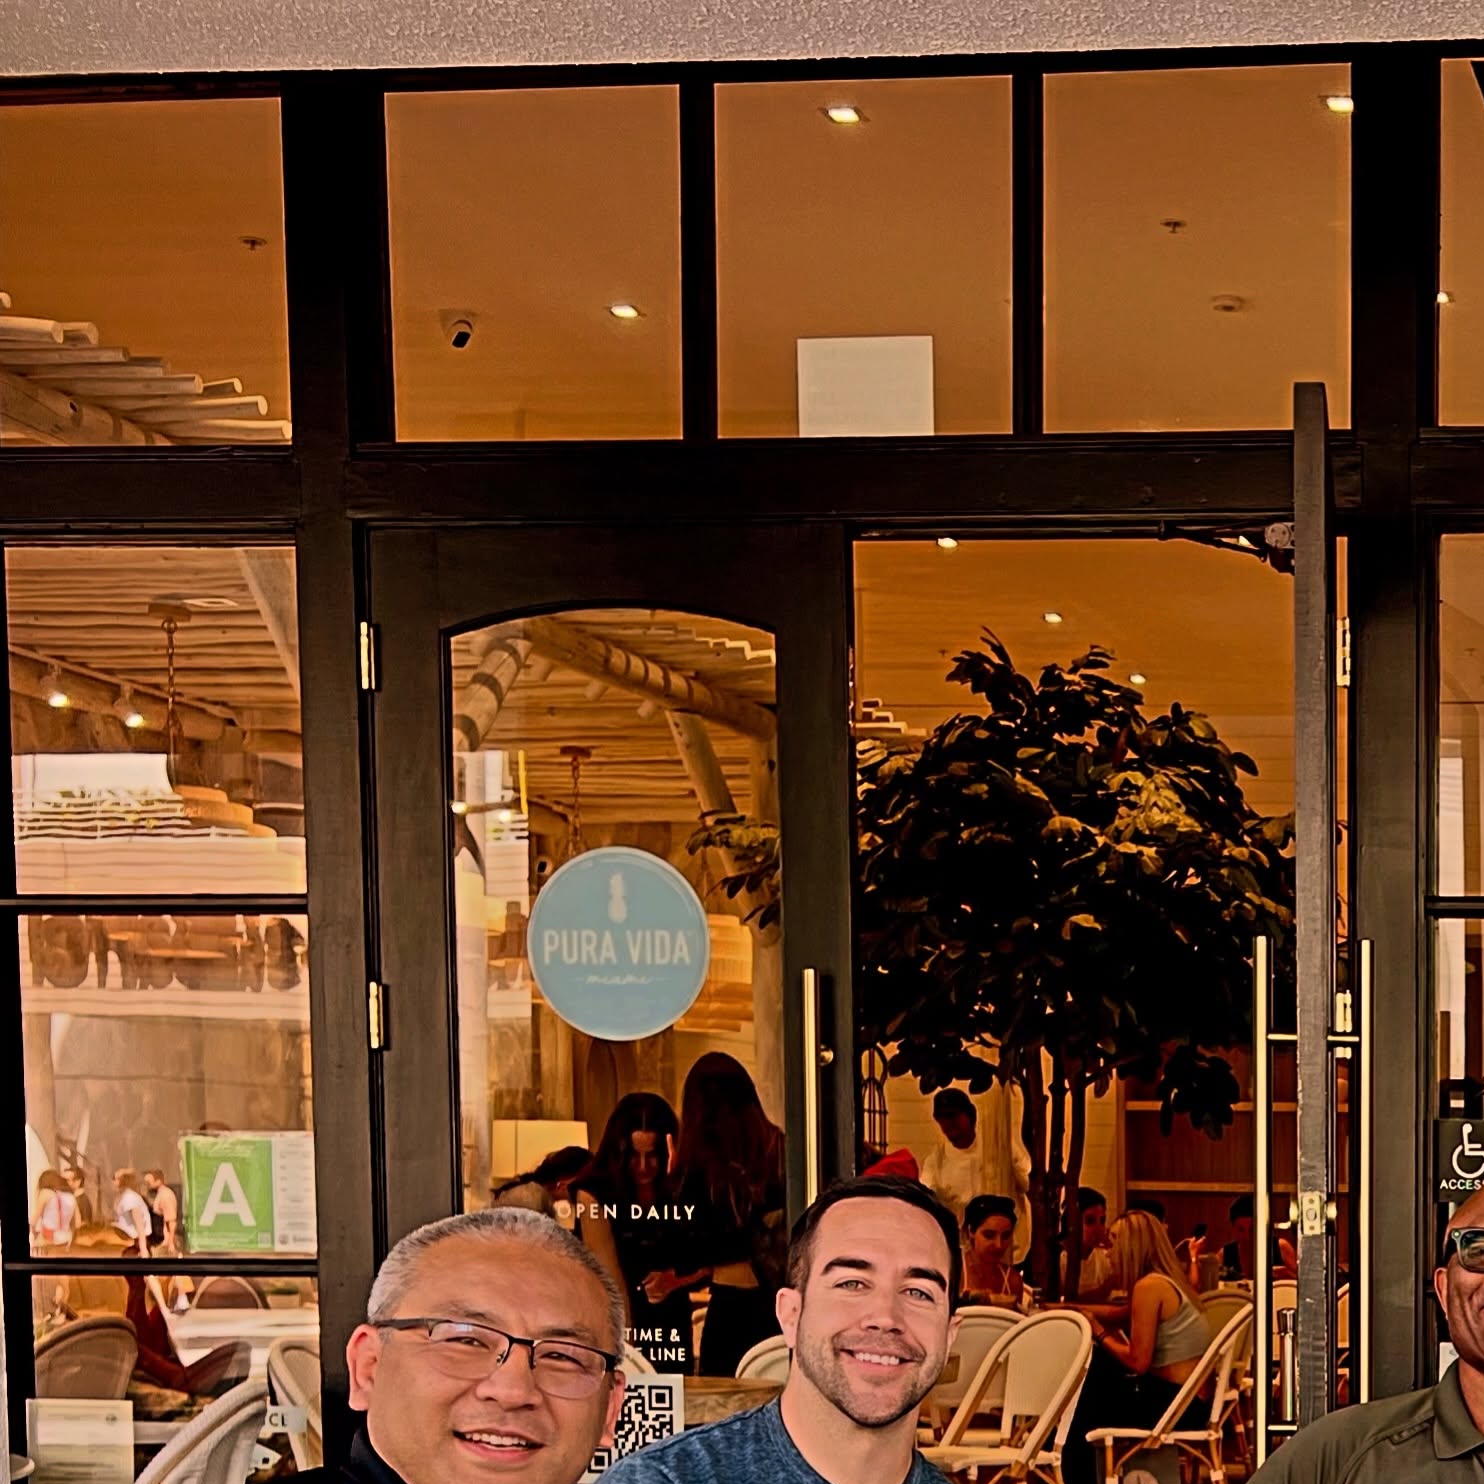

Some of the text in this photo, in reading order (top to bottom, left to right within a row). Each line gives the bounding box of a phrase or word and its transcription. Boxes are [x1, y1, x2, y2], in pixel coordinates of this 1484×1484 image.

[543, 929, 692, 966] PURA VIDA
[199, 1161, 257, 1227] A
[556, 1203, 695, 1221] OPEN DAILY
[625, 1327, 681, 1343] TIME &
[650, 1347, 686, 1362] LINE
